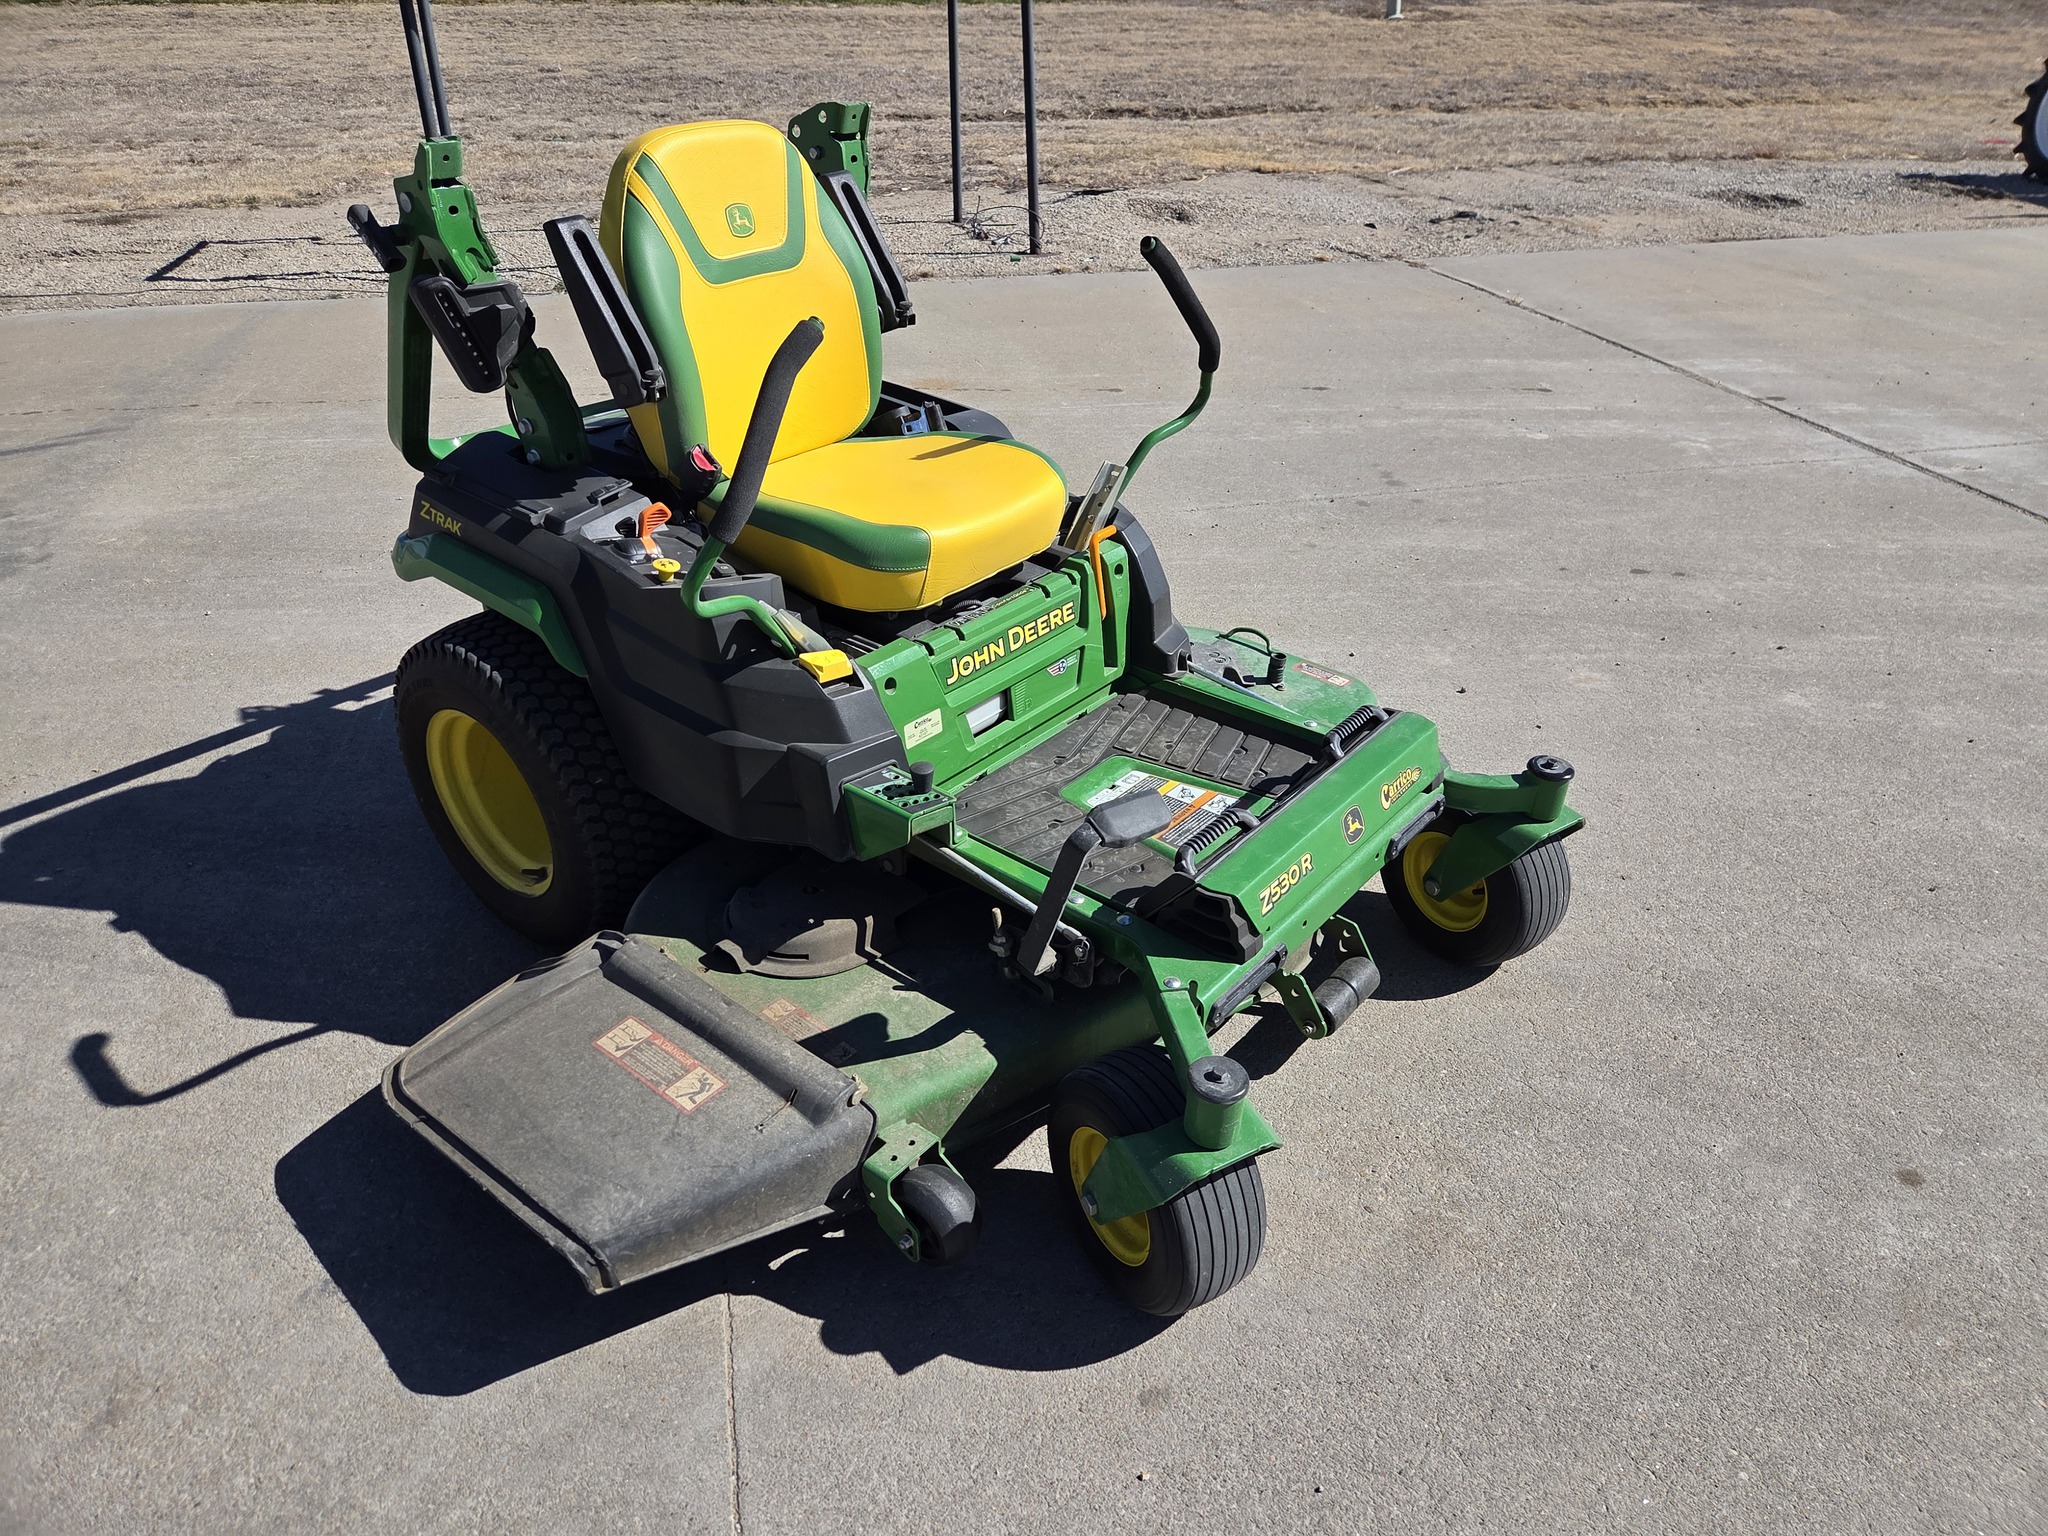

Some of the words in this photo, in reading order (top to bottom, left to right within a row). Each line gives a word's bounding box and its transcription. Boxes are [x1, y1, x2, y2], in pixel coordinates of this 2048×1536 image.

[420, 500, 461, 537] ZTRAK
[946, 637, 1006, 686] JOHN
[1007, 600, 1075, 653] DEERE
[1380, 767, 1412, 811] Carrico
[661, 1041, 694, 1066] DANGER
